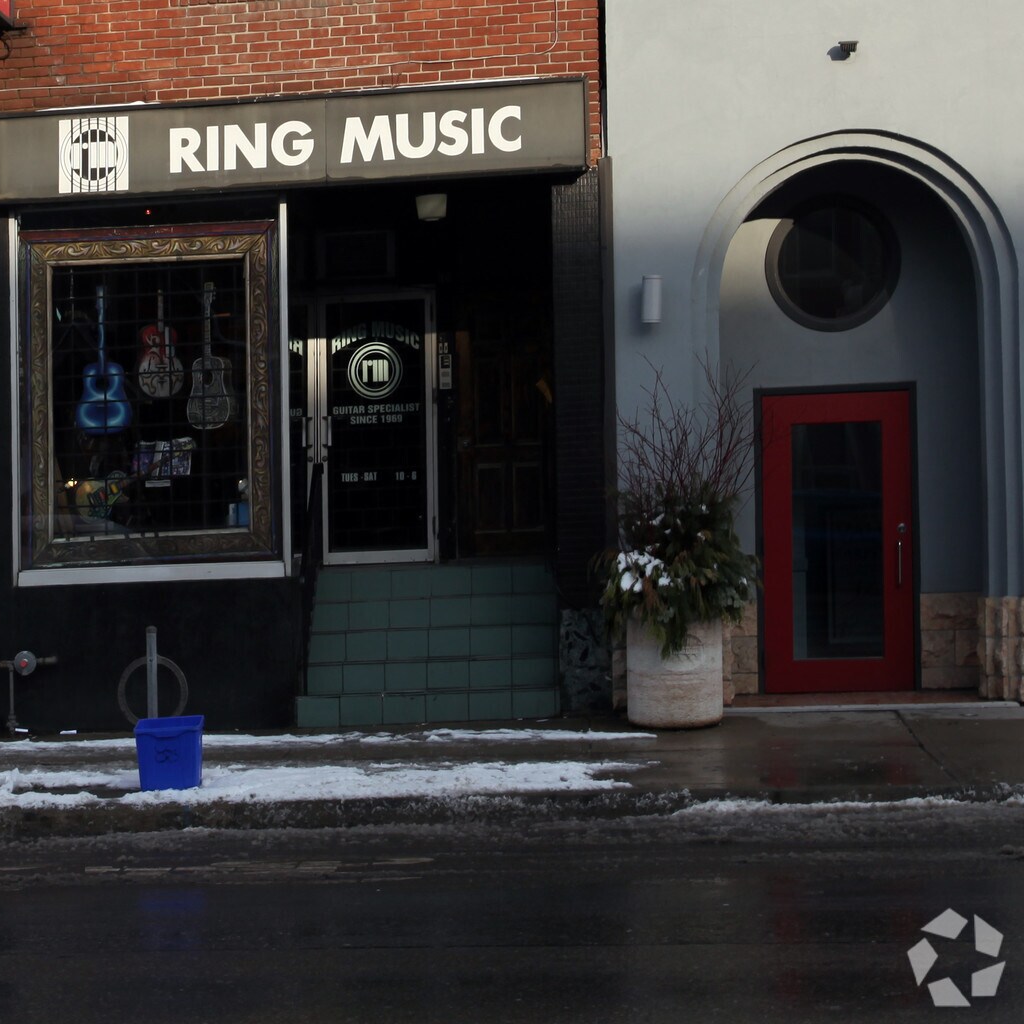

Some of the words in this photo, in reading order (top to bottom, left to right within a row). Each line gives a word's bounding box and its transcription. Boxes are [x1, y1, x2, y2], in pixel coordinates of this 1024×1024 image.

[169, 120, 314, 174] RING
[340, 105, 522, 164] MUSIC
[331, 322, 367, 355] RING
[371, 320, 420, 350] MUSIC
[332, 405, 365, 415] GUITAR
[367, 402, 420, 414] SPECIALIST
[350, 416, 378, 425] SINCE
[341, 472, 359, 482] TUES
